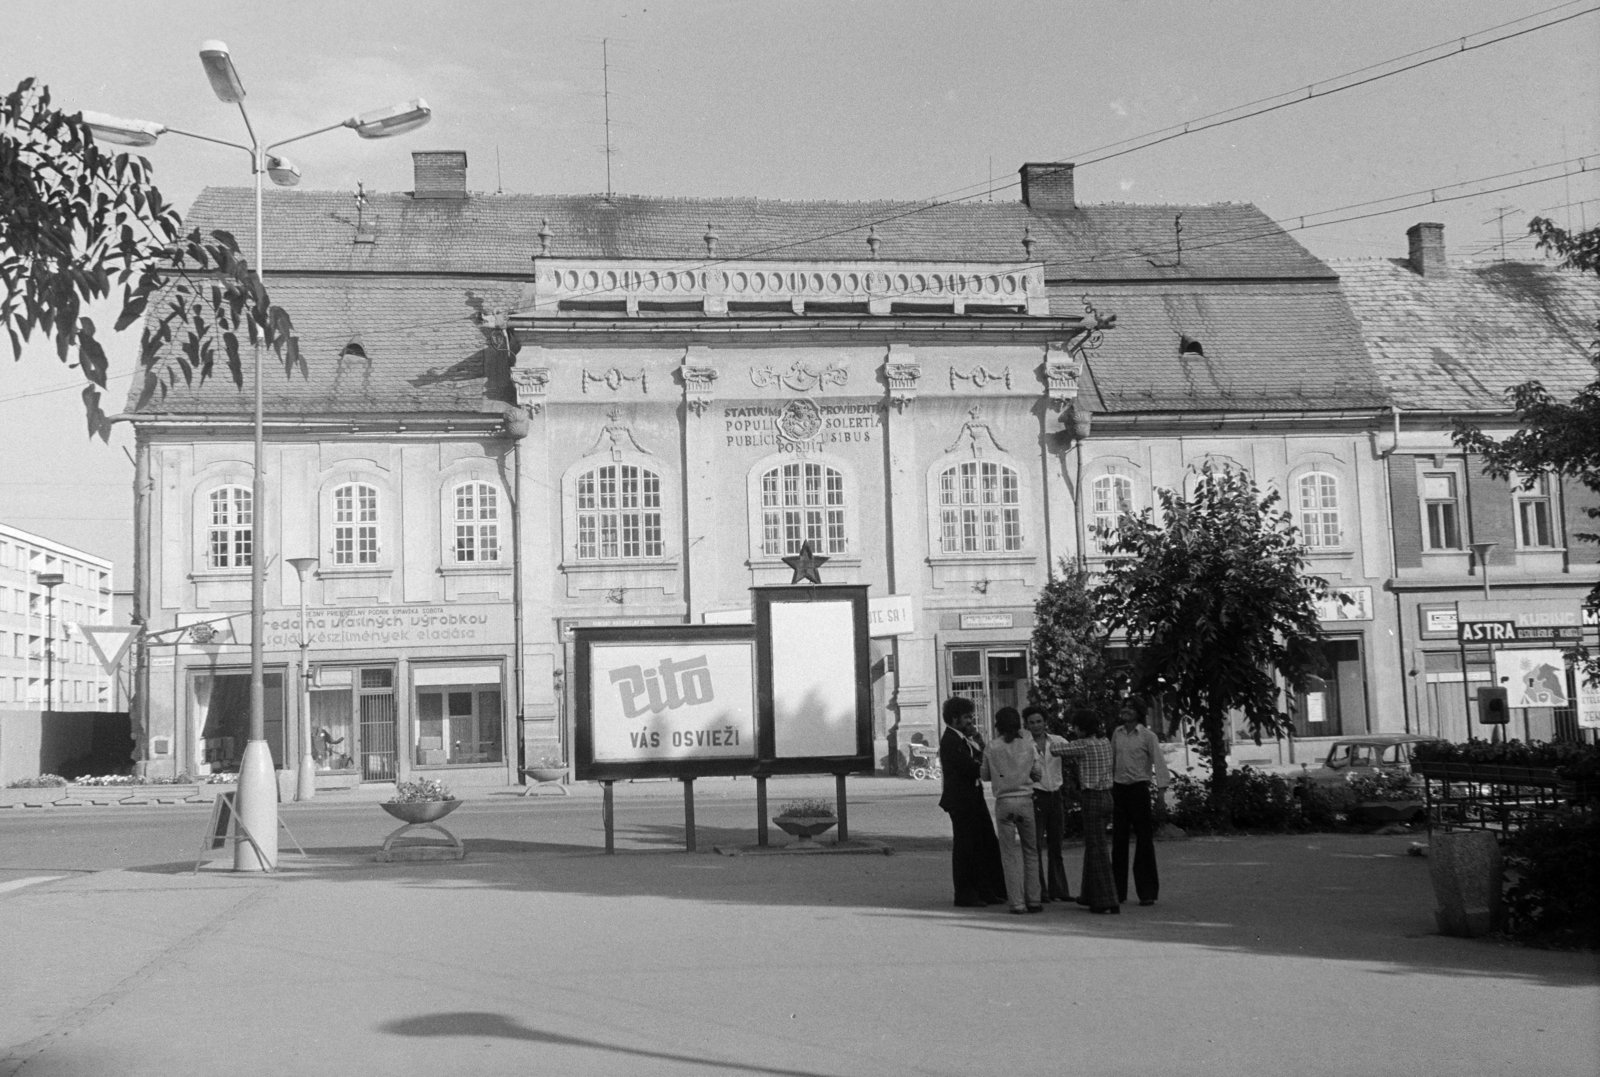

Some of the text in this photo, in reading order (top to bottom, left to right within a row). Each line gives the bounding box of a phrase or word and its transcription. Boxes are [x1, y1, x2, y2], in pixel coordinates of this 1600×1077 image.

[726, 417, 774, 432] POPULI
[726, 432, 781, 447] PUBLICIS
[777, 438, 824, 453] POSUIT
[887, 608, 900, 622] SA
[1462, 622, 1516, 640] ASTRA
[608, 655, 715, 719] Pito
[630, 725, 740, 748] VÁS OSVIEŽI
